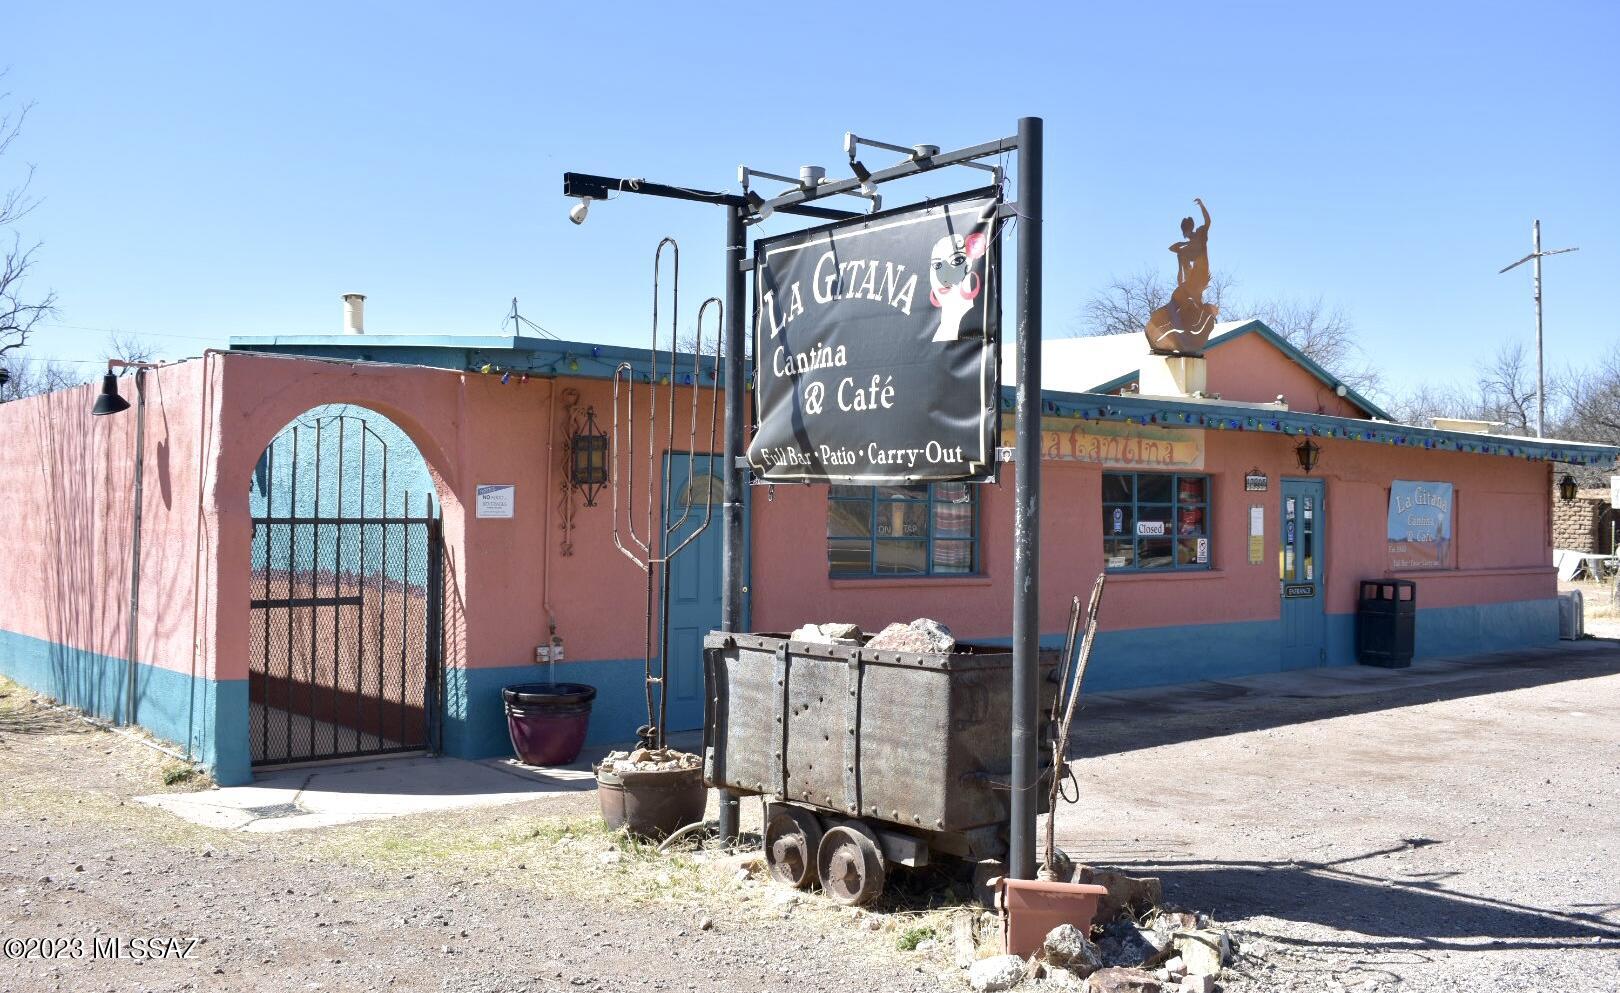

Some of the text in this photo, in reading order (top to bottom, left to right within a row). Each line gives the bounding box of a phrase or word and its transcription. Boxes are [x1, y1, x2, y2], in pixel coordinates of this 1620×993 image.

[764, 251, 918, 339] LA GITANA
[773, 342, 847, 378] Cantina
[804, 374, 895, 415] & Café
[761, 440, 963, 467] Full Bar Patio Carry-Out
[1069, 424, 1174, 465] Cantina
[1138, 523, 1163, 535] Closed
